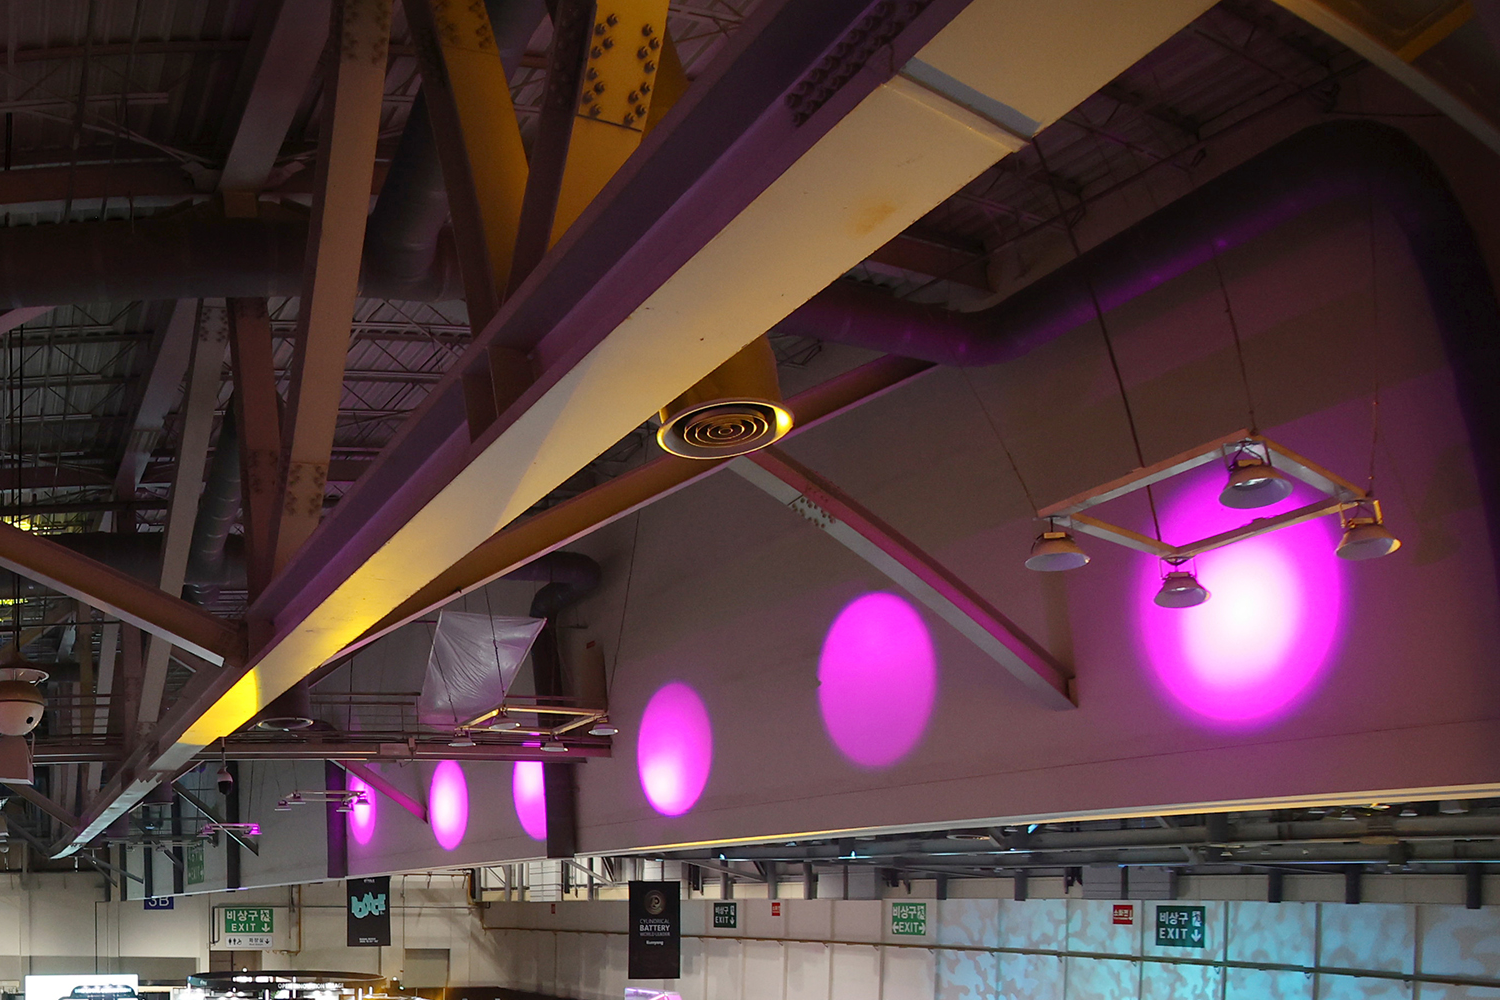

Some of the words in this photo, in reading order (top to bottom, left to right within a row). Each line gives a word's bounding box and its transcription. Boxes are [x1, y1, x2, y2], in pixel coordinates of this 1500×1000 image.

[227, 911, 259, 921] 비상구
[893, 906, 917, 919] 비상구
[715, 916, 729, 924] EXIT
[1160, 912, 1188, 925] 비상구
[231, 923, 256, 931] EXIT
[900, 922, 919, 933] EXIT
[1160, 928, 1188, 939] EXIT
